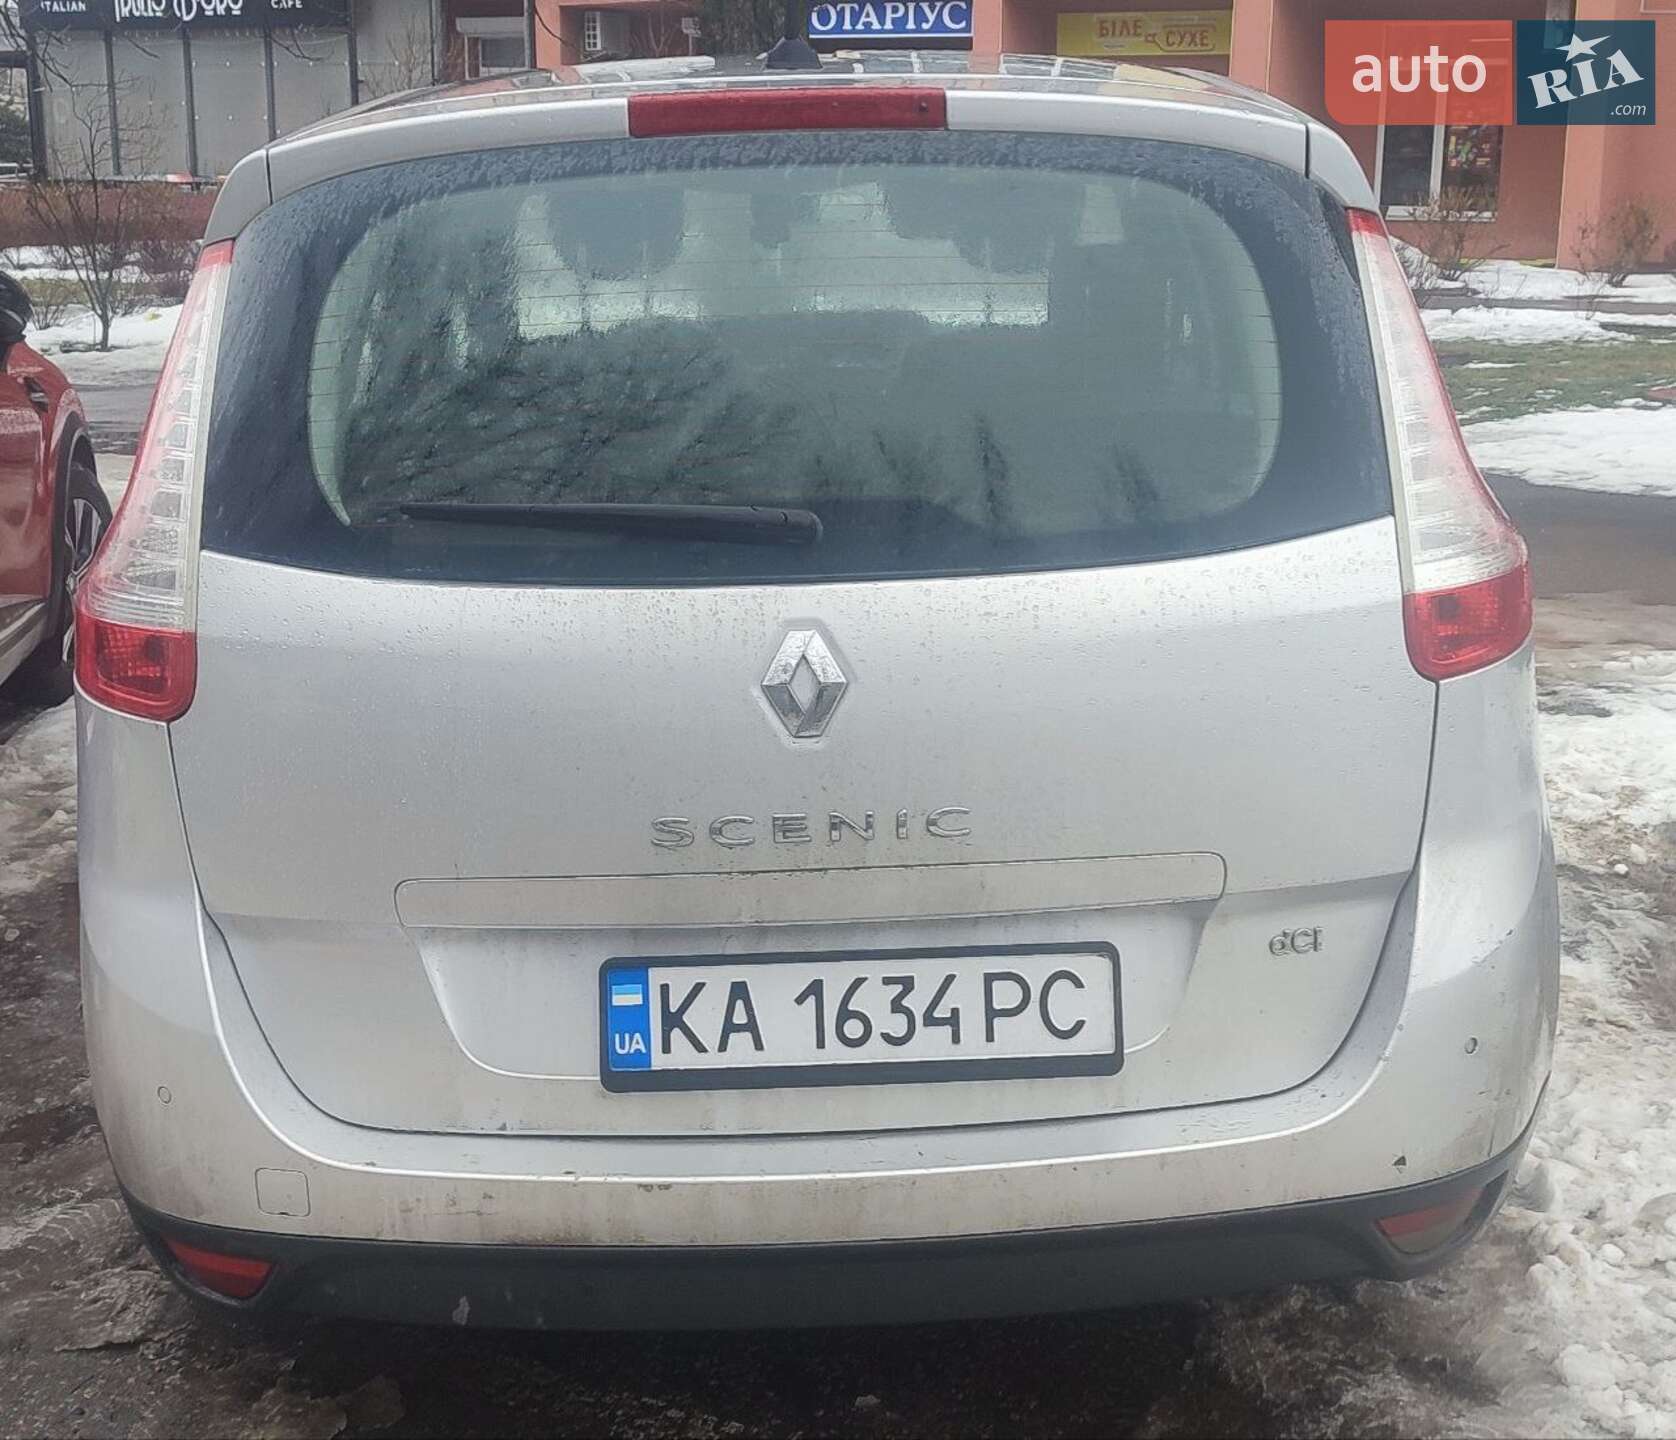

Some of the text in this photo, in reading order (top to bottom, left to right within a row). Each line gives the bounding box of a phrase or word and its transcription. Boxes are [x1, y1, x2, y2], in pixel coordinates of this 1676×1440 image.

[40, 0, 86, 12] ITALIAN
[173, 0, 243, 21] DORO
[810, 1, 967, 31] ОТАРІУС
[1098, 19, 1142, 38] БІЛЕ
[1166, 29, 1209, 48] СУХЕ
[650, 806, 972, 848] SCENIC
[658, 969, 1087, 1054] KA 1634 PC
[614, 1032, 647, 1055] UA
